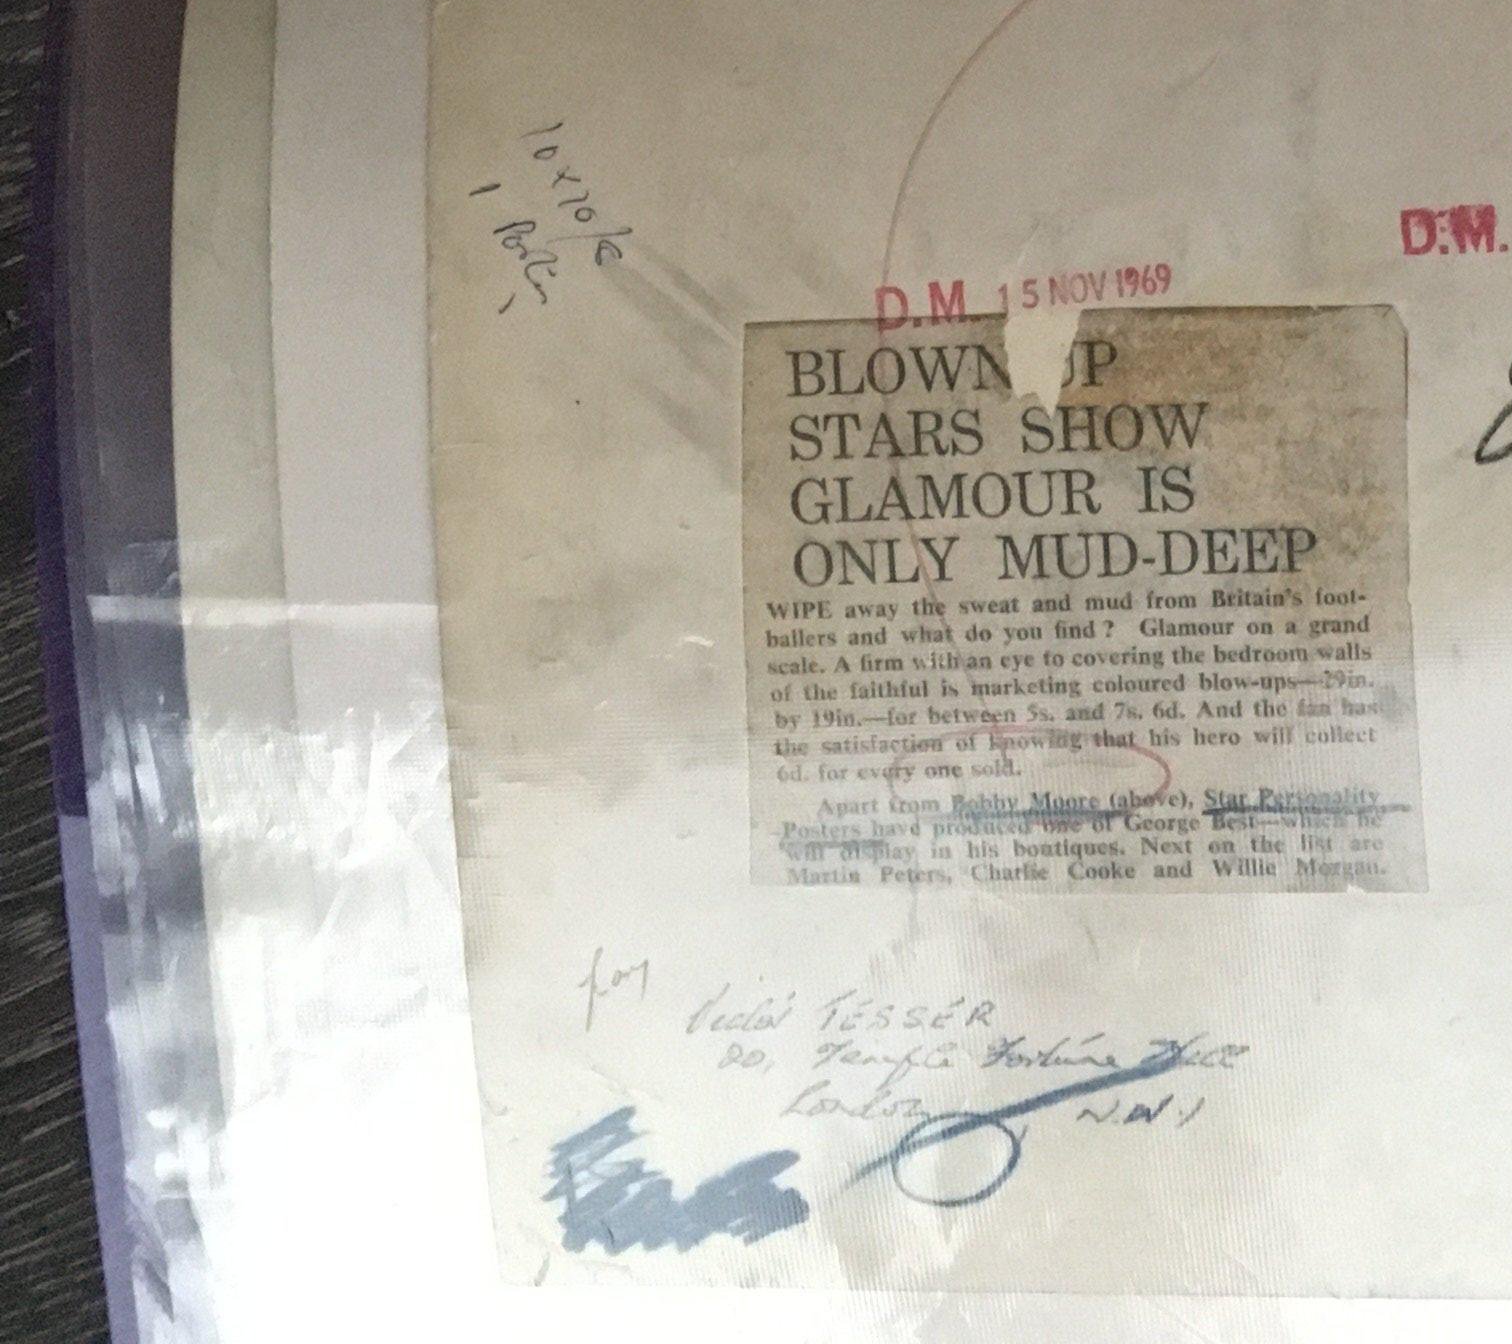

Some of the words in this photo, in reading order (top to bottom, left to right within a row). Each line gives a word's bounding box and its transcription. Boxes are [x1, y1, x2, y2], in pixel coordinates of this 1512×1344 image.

[1401, 204, 1508, 254] D.M.
[998, 278, 1040, 313] 15
[1049, 270, 1106, 305] NOV
[1115, 263, 1172, 298] 1969
[789, 408, 984, 461] STARS
[1020, 403, 1209, 454] SHOW
[790, 468, 1103, 524] GLAMOUR
[1138, 466, 1195, 513] IS
[793, 536, 961, 587] ONLY
[996, 529, 1318, 583] MUD-DEEP
[766, 600, 832, 619] WIPE
[845, 602, 898, 620] away
[912, 597, 947, 616] the
[958, 597, 1019, 614] sweat
[1031, 594, 1070, 612] and
[1085, 592, 1132, 611] mud
[1146, 591, 1196, 609] from
[1211, 588, 1303, 608] Britain's
[1315, 587, 1366, 606] foot-
[765, 628, 836, 648] ballers
[848, 627, 886, 646] and
[901, 625, 952, 643] what
[964, 624, 992, 642] do
[1003, 625, 1042, 648] you
[1054, 620, 1095, 639] find
[1140, 618, 1234, 637] Glamour
[1246, 621, 1273, 635] on
[1285, 620, 1296, 634] a
[1308, 615, 1369, 639] grand
[767, 656, 825, 675] scale.
[833, 656, 850, 673] A
[860, 653, 903, 672] firm
[912, 651, 959, 671] with
[966, 655, 992, 670] an
[1000, 653, 1034, 673] eye
[1043, 652, 1065, 667] to
[1072, 645, 1164, 669] covering
[1172, 645, 1202, 663] the
[1213, 644, 1308, 662] bedroom
[1317, 642, 1372, 660] walls
[770, 683, 793, 702] of
[803, 683, 838, 701] the
[850, 680, 928, 699] faithful
[941, 678, 959, 697] is
[971, 676, 1082, 697] marketing
[1092, 673, 1185, 693] coloured
[774, 709, 801, 729] by
[928, 704, 1016, 726] between
[1026, 703, 1054, 722] 5s.
[1064, 702, 1104, 722] and
[1114, 701, 1143, 720] 7s.
[1152, 701, 1185, 719] 6d.
[1197, 700, 1243, 718] And
[1253, 699, 1287, 717] the
[774, 739, 809, 756] the
[821, 734, 943, 755] satisfaction
[956, 734, 976, 751] of
[989, 732, 1082, 752] knowing
[1093, 729, 1135, 747] that
[1150, 728, 1180, 746] his
[1194, 727, 1241, 745] hero
[1254, 725, 1293, 744] will
[1305, 725, 1377, 743] collect
[777, 765, 809, 783] 6d.
[818, 763, 848, 782] for
[857, 765, 915, 784] every
[924, 765, 963, 779] one
[971, 759, 1021, 778] sold.
[818, 798, 878, 818] Apart
[888, 795, 940, 813] from
[951, 793, 1018, 813] Bobby
[1031, 791, 1098, 810] Moore
[1109, 788, 1193, 809] (above),
[1204, 788, 1248, 807] Star
[1258, 786, 1380, 807] Personality
[782, 821, 861, 841] Posters
[1124, 813, 1199, 835] George
[931, 843, 950, 859] in
[967, 841, 999, 858] his
[1013, 837, 1124, 859] boutiques.
[1140, 836, 1192, 855] Next
[1208, 839, 1235, 854] on
[1251, 835, 1286, 854] the
[1301, 834, 1333, 853] list
[1351, 838, 1384, 851] are
[880, 864, 952, 885] Peters,
[971, 861, 1048, 882] Charlie
[1068, 861, 1136, 881] Cooke
[1154, 860, 1193, 878] and
[1213, 859, 1277, 878] Willie
